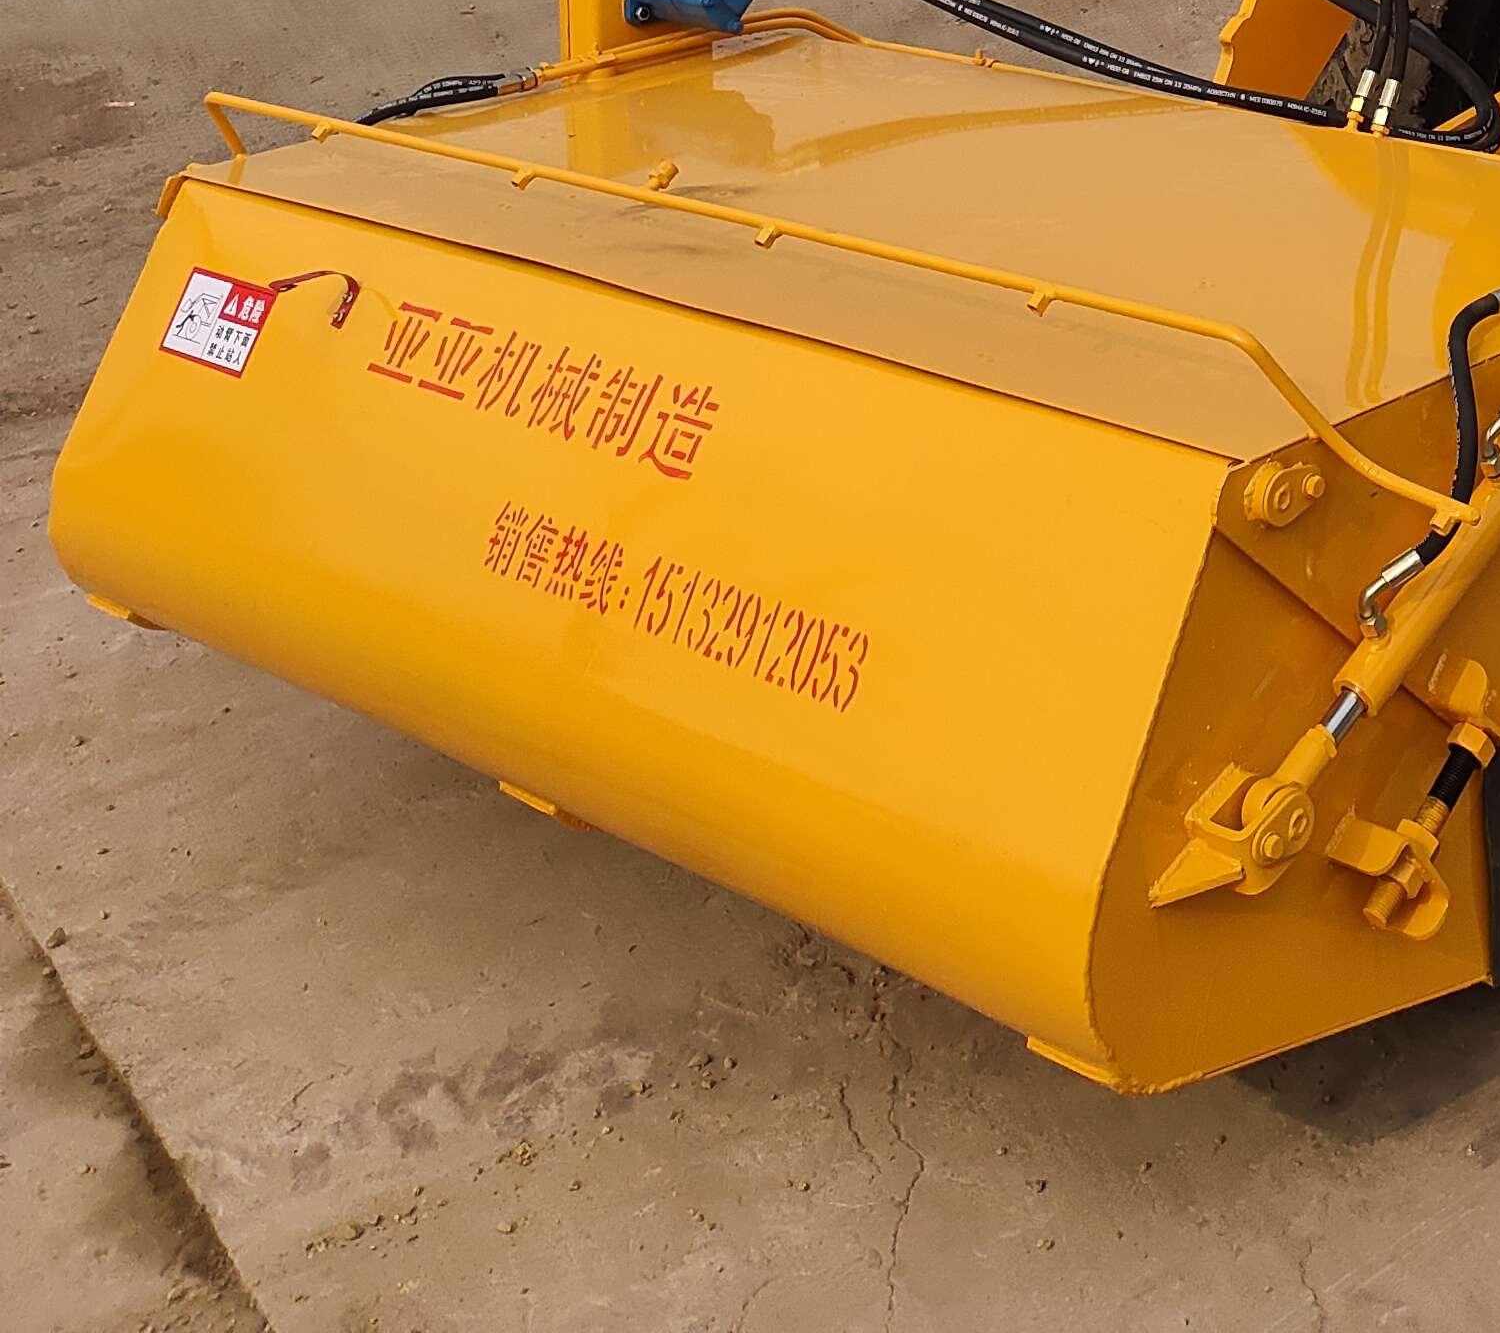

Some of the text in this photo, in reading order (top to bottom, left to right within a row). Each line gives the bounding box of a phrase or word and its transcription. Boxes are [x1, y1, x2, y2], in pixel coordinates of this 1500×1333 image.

[238, 296, 265, 323] 危险
[215, 325, 252, 348] 动臂下面
[207, 342, 241, 366] 禁止站人
[367, 301, 719, 480] 亚亚机械制造
